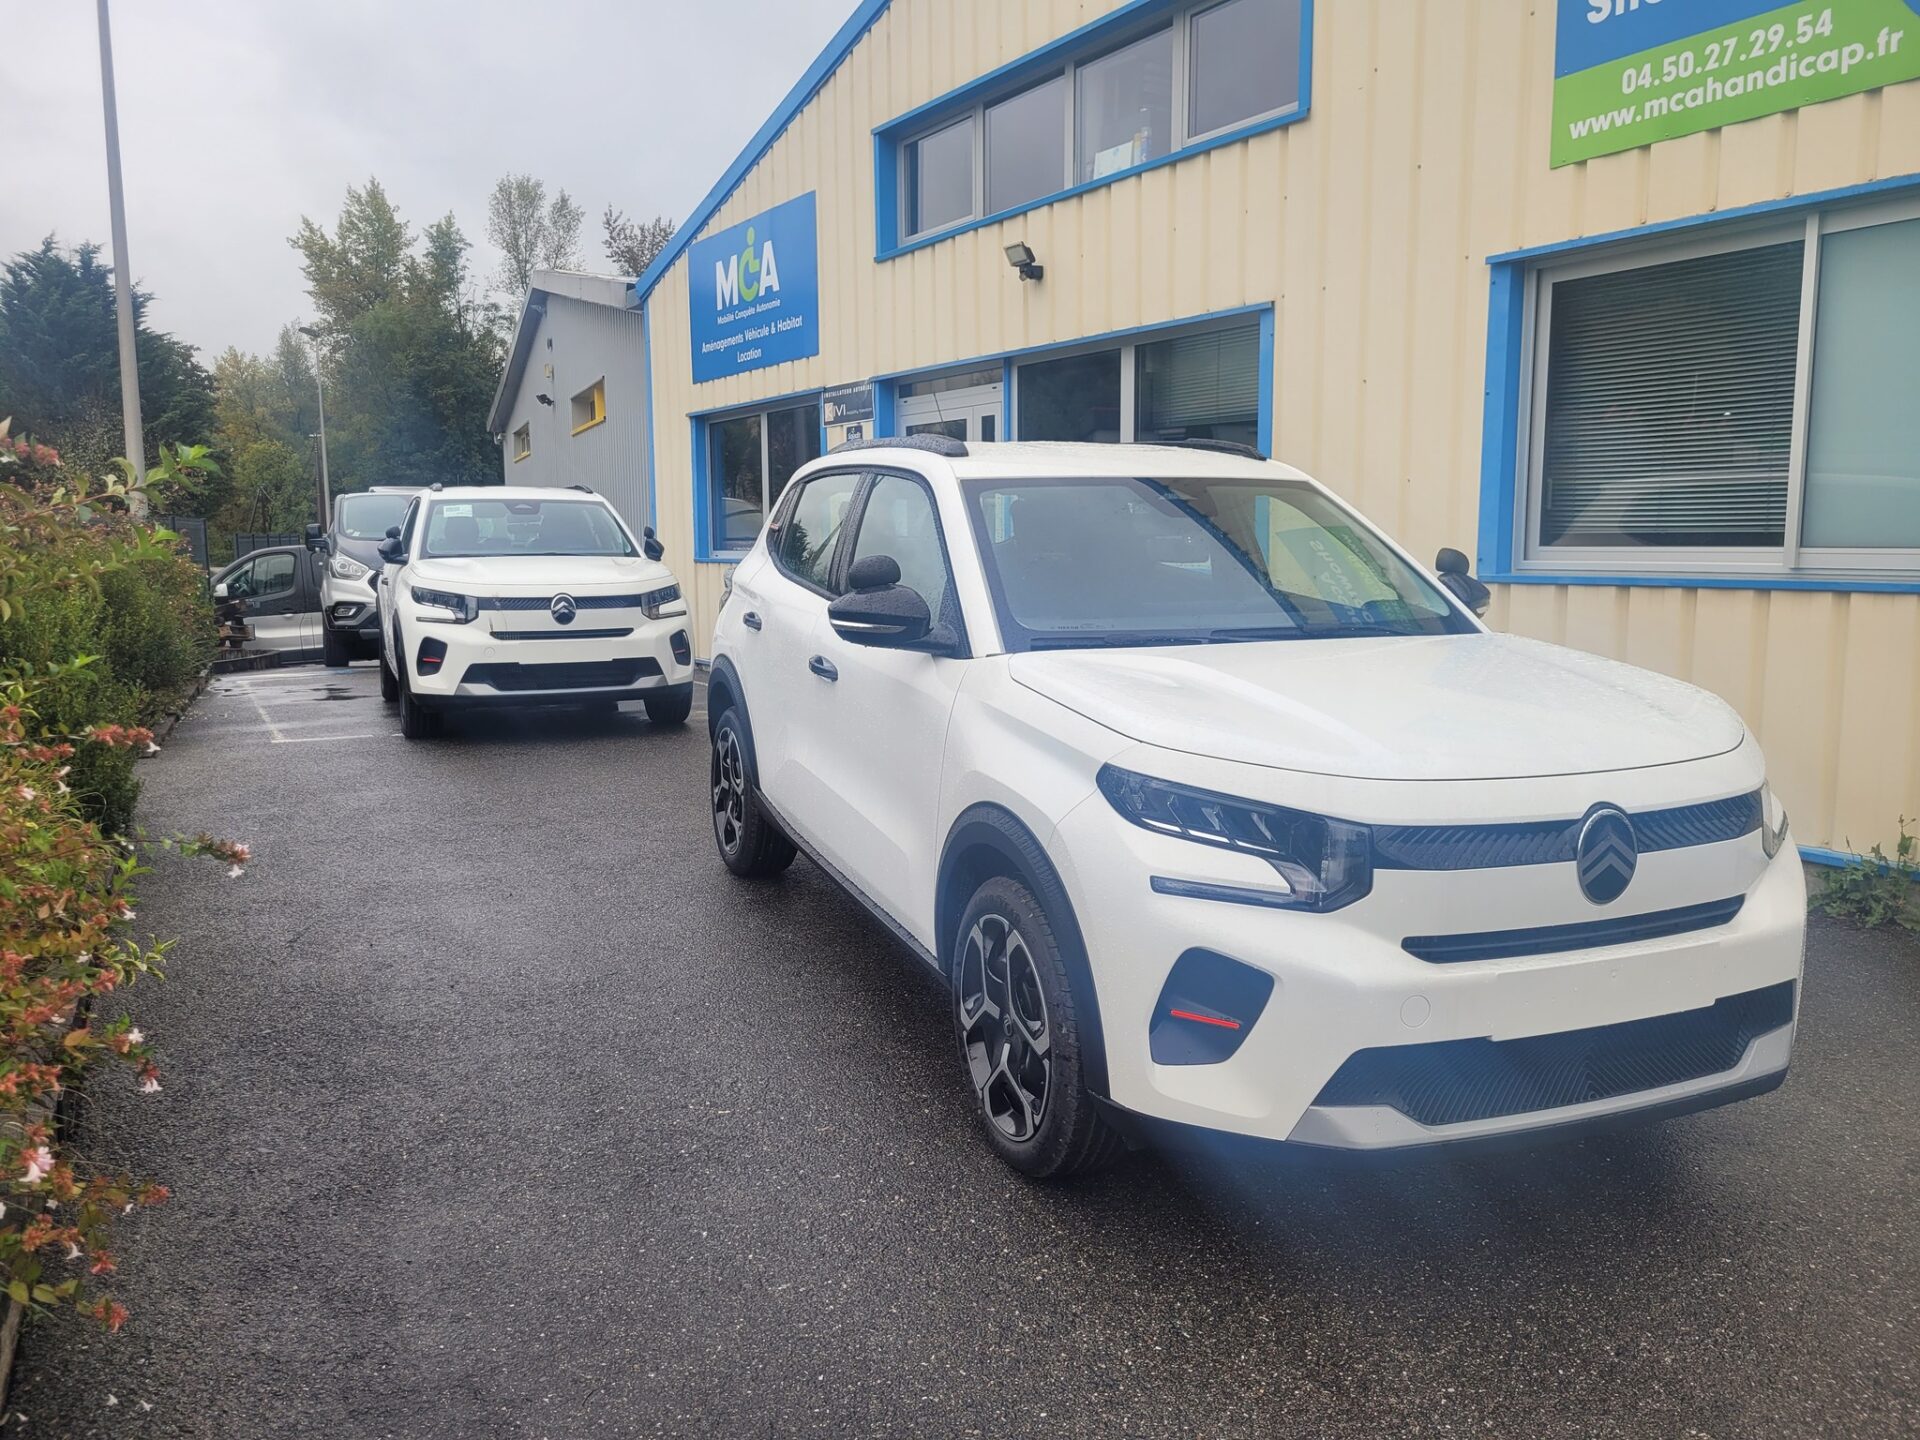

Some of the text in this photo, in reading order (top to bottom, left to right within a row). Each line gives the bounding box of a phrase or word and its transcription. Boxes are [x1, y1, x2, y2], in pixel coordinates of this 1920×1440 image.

[1621, 8, 1833, 95] 04.50.27.29.54
[1568, 26, 1904, 140] www.mcahandicap.fr
[715, 239, 780, 311] MCA
[702, 315, 803, 354] Aménagements Véhicule & Habitat
[717, 298, 781, 325] Mobilité Conquête Autonomie
[737, 347, 762, 363] Location
